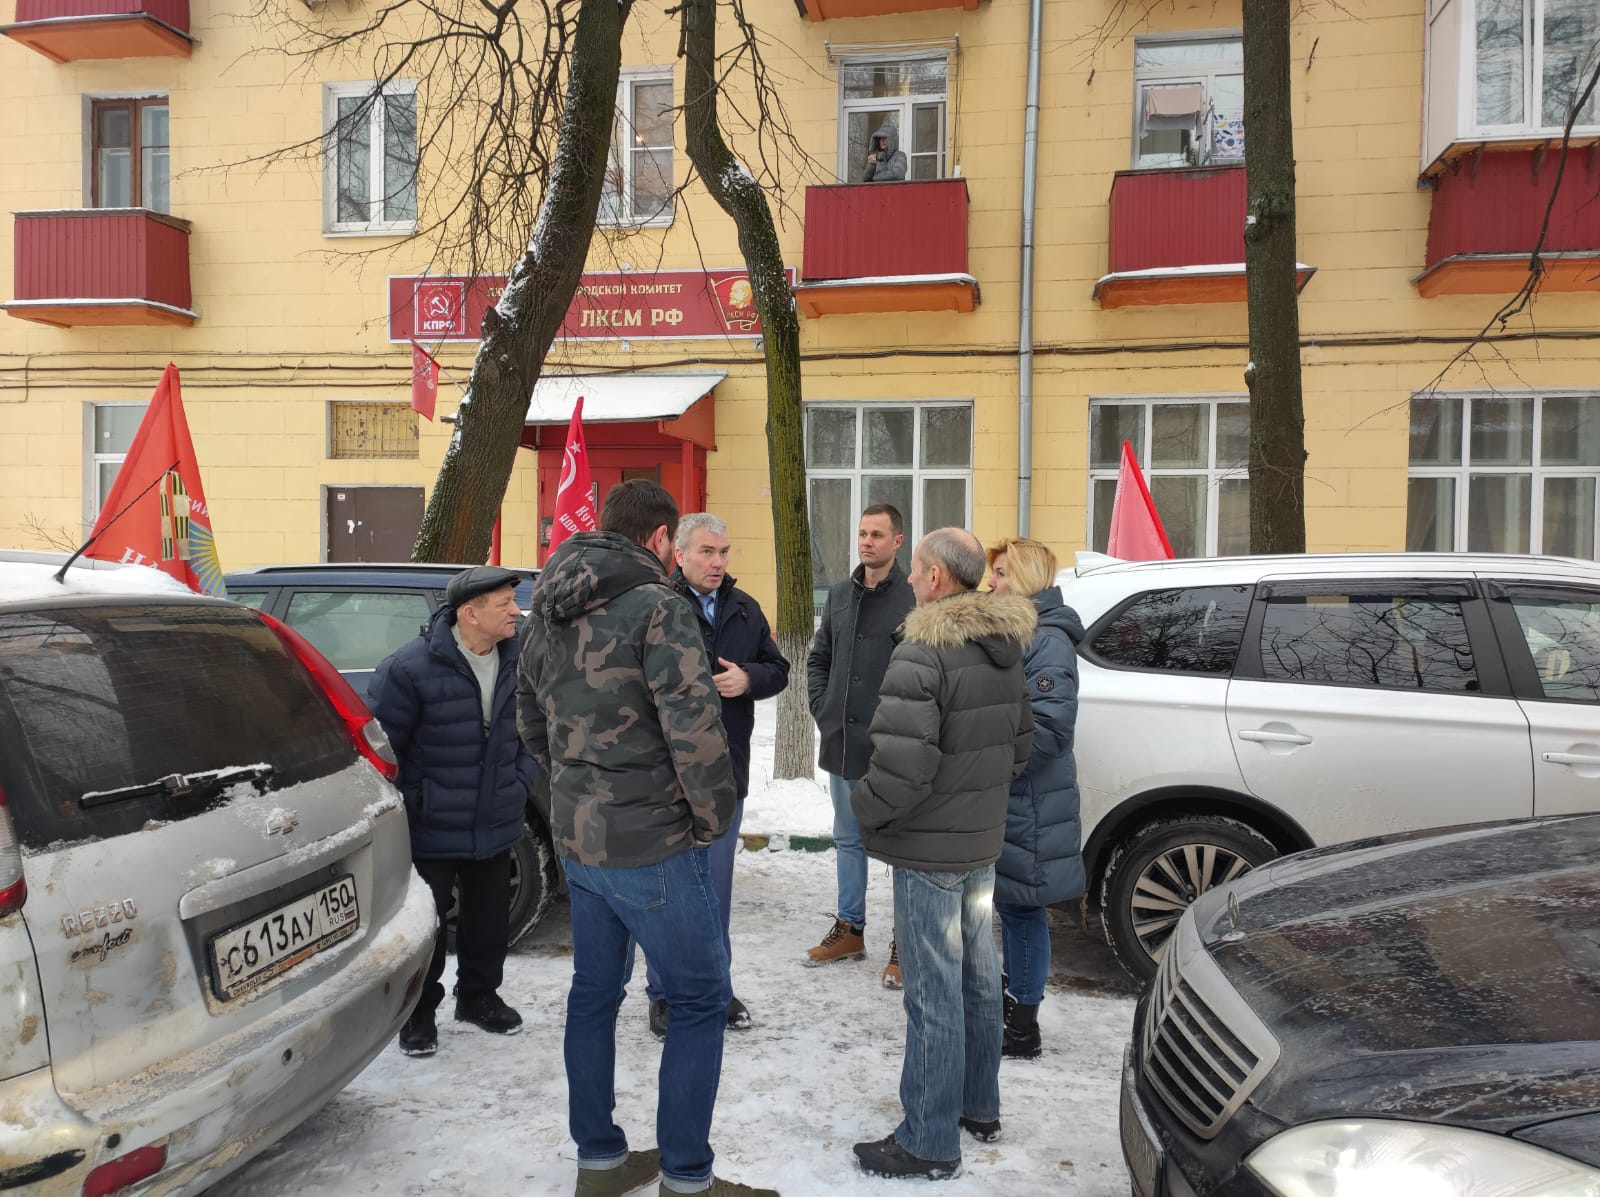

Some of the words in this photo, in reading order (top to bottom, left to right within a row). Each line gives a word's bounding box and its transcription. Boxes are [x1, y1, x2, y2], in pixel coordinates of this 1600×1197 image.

[576, 284, 627, 296] РОДСКОЙ
[631, 284, 682, 295] КОМИТЕТ
[423, 320, 456, 330] КПРФ
[581, 308, 642, 327] ЛКСМ
[651, 308, 684, 326] РФ
[319, 883, 351, 917] 150
[62, 898, 137, 939] REZZO
[329, 912, 345, 927] RUS
